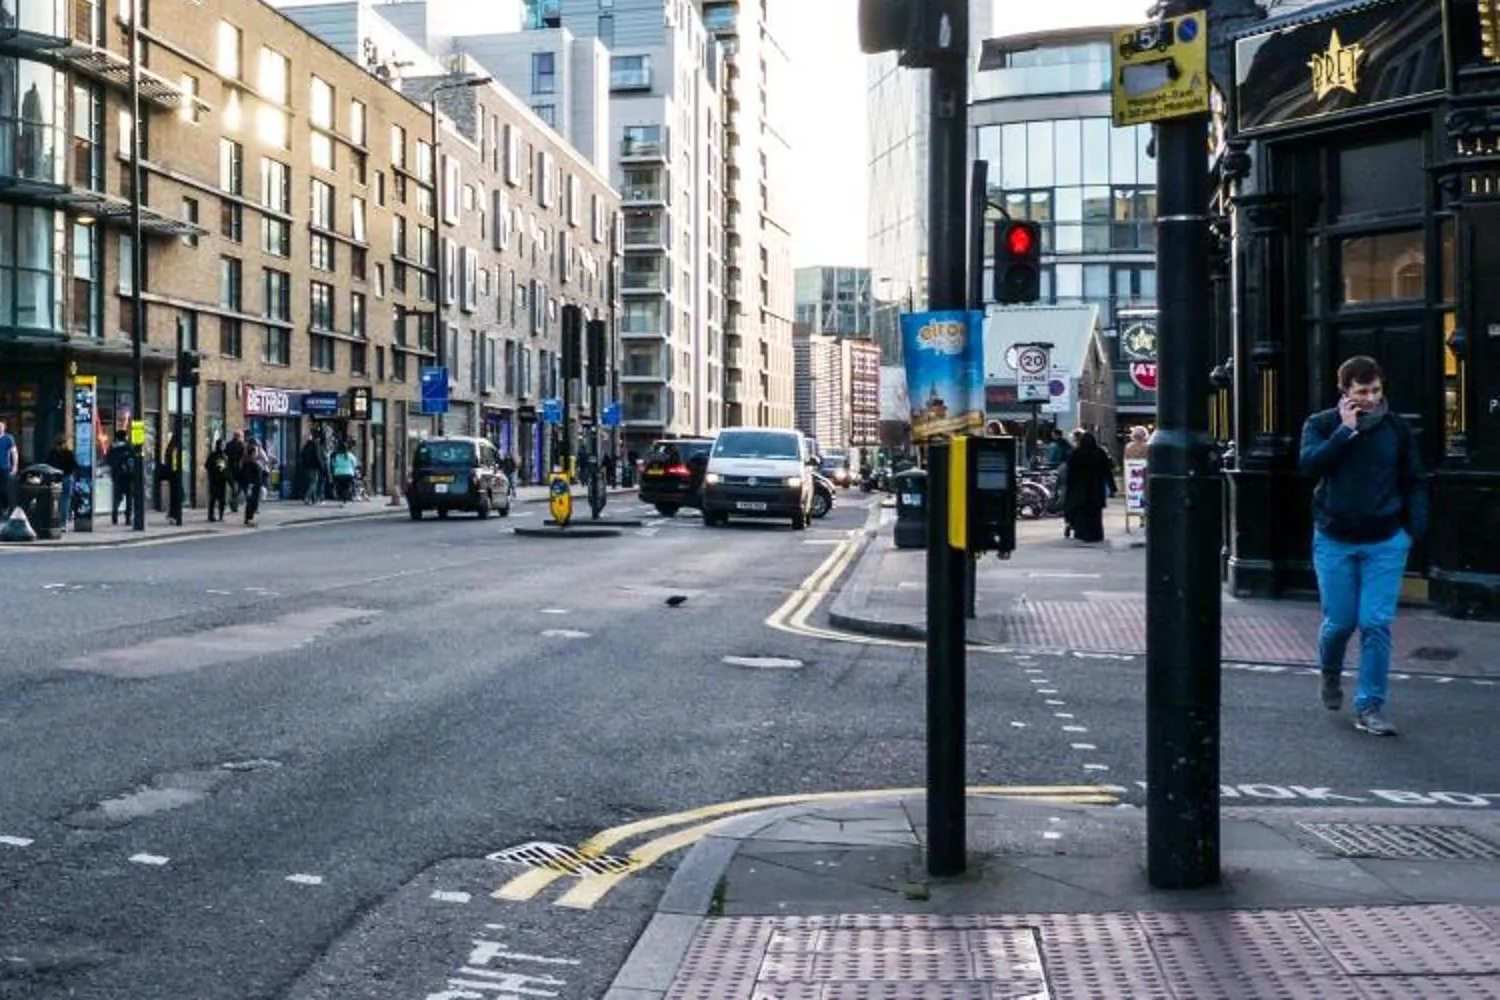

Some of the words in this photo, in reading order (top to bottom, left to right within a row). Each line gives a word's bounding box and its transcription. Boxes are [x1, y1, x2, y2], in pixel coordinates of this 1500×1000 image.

[1312, 43, 1361, 91] PRET
[1023, 355, 1043, 367] 20
[1133, 362, 1157, 377] AT
[247, 389, 289, 412] BETFRED
